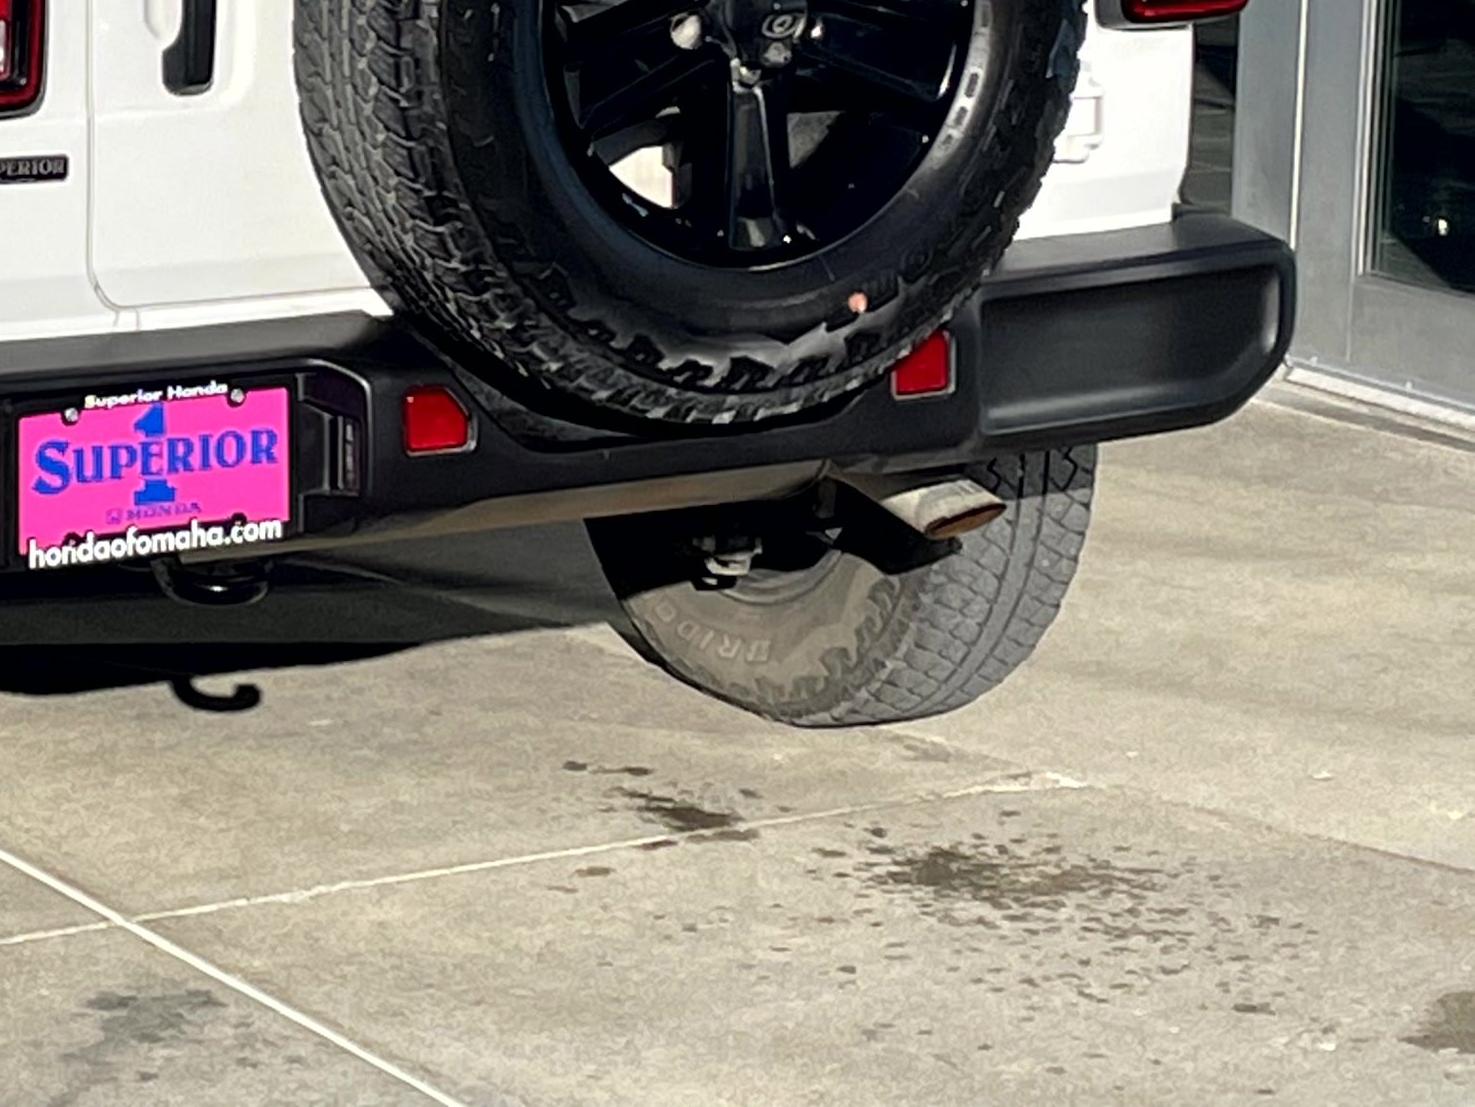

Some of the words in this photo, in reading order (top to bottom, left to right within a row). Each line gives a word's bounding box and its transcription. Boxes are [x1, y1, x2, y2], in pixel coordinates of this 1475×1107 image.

[84, 389, 163, 409] Superior
[167, 380, 229, 400] Honda
[32, 428, 279, 495] SUPERIOR
[126, 501, 203, 521] HONDA
[27, 518, 283, 570] hondaofomaha.com
